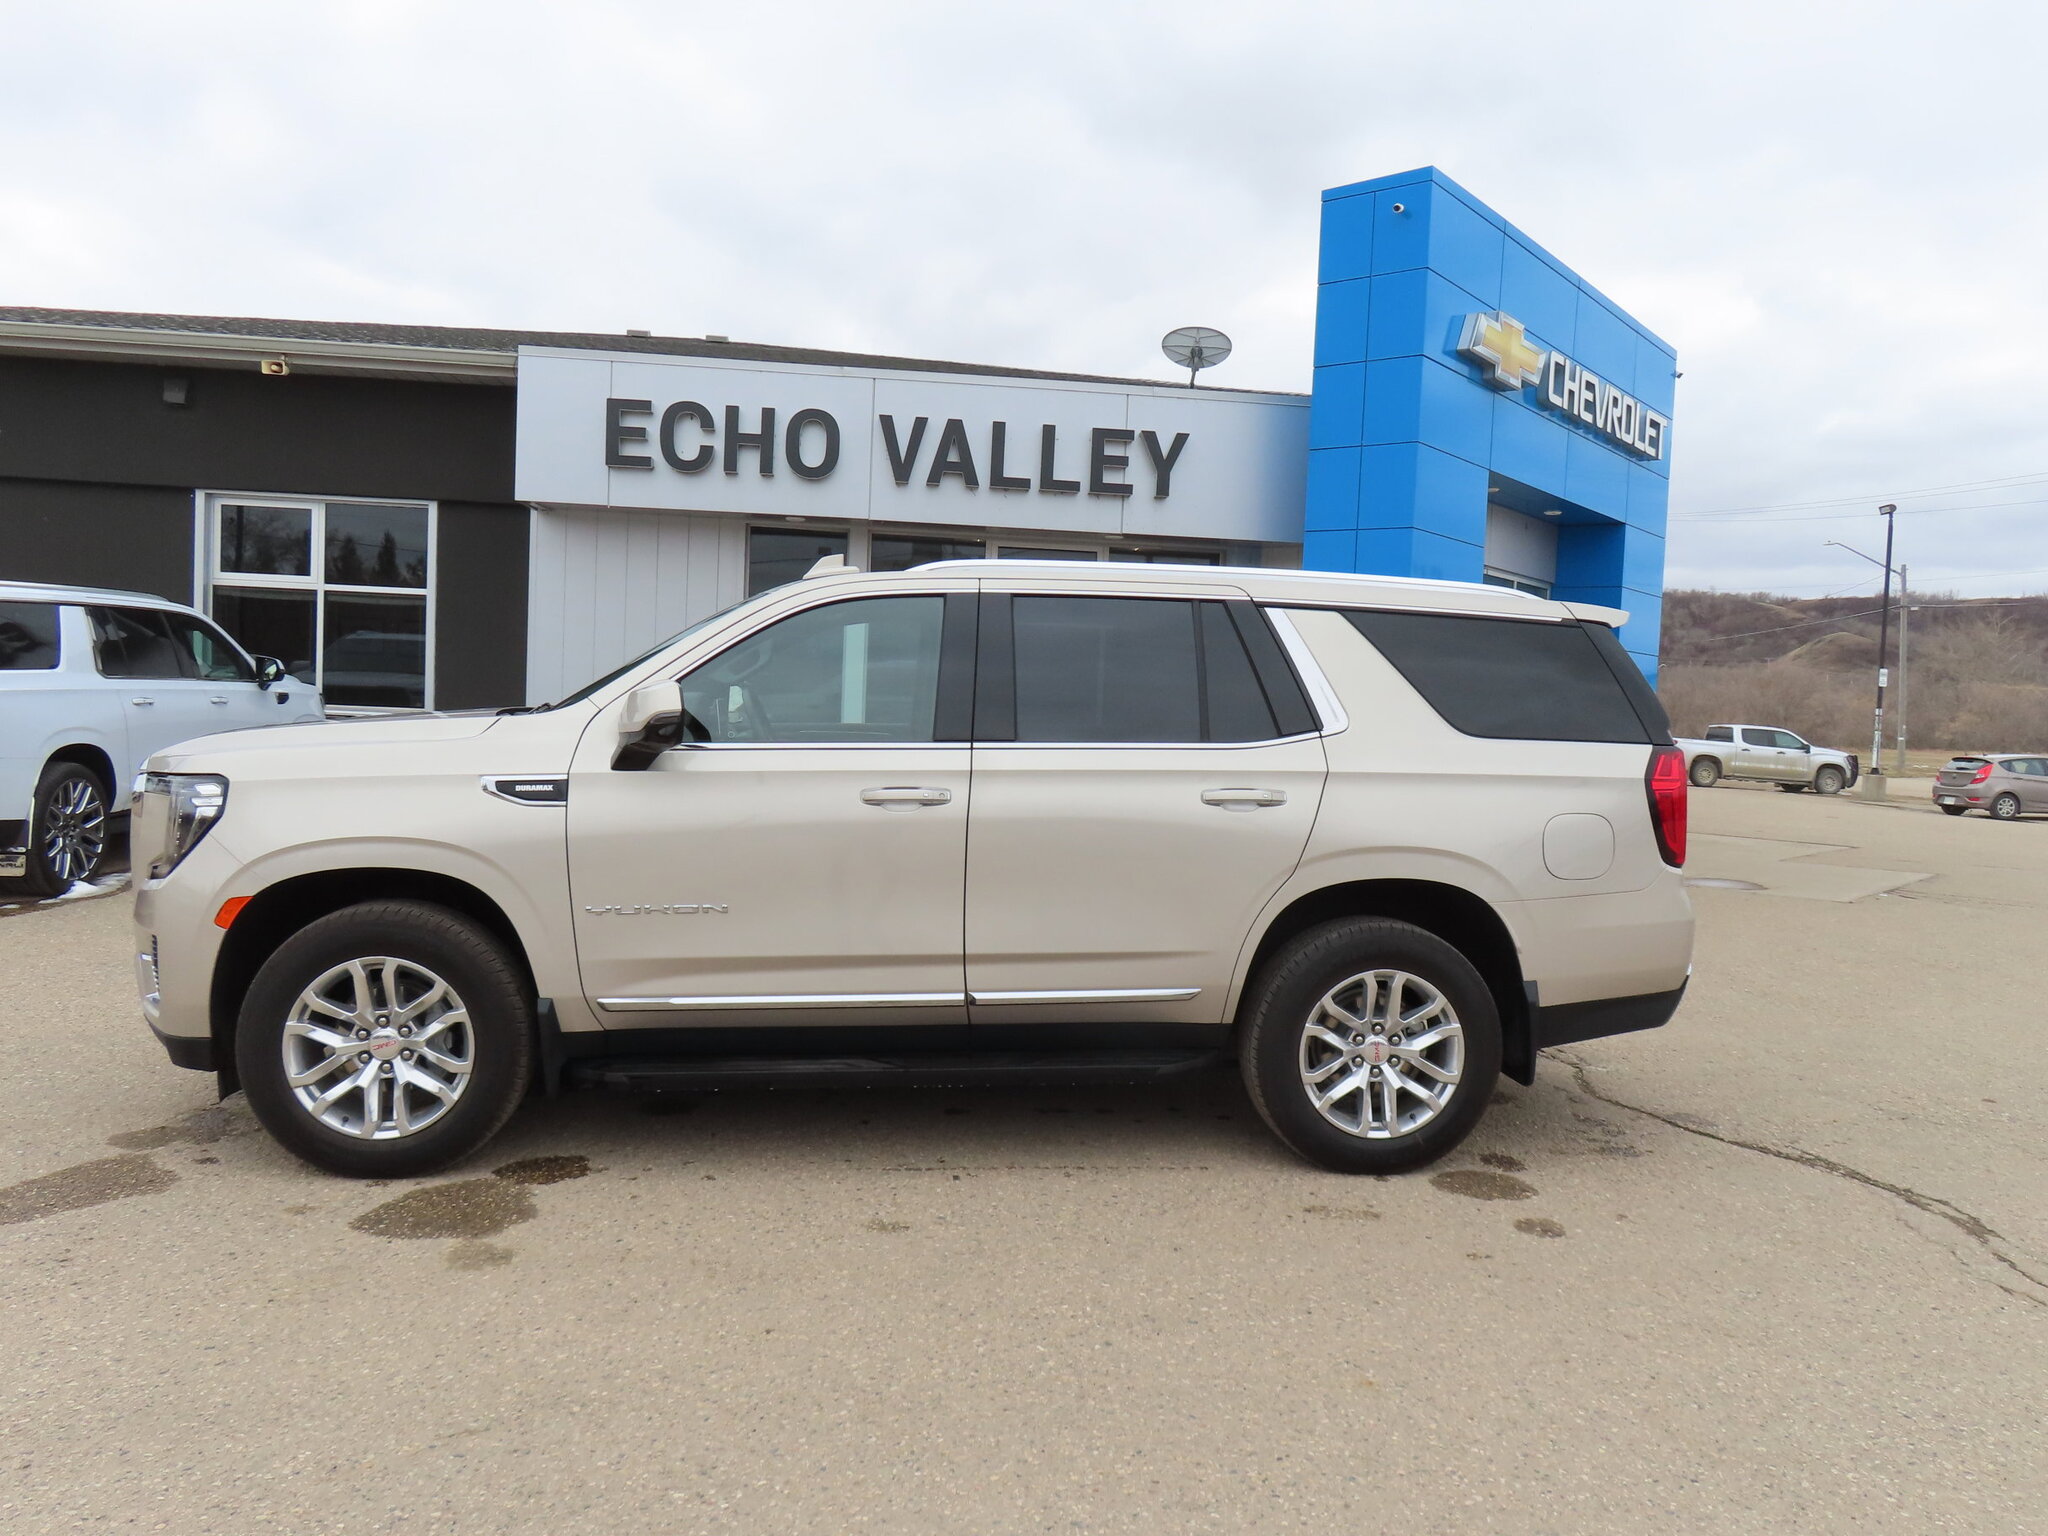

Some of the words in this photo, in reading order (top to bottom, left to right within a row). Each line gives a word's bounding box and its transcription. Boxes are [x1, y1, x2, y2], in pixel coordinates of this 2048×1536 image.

[1546, 350, 1668, 461] CHEVROLET
[605, 397, 841, 480] ECHO
[879, 414, 1191, 499] VALLEY
[515, 784, 554, 792] DURAMAX
[585, 904, 730, 916] YUKON
